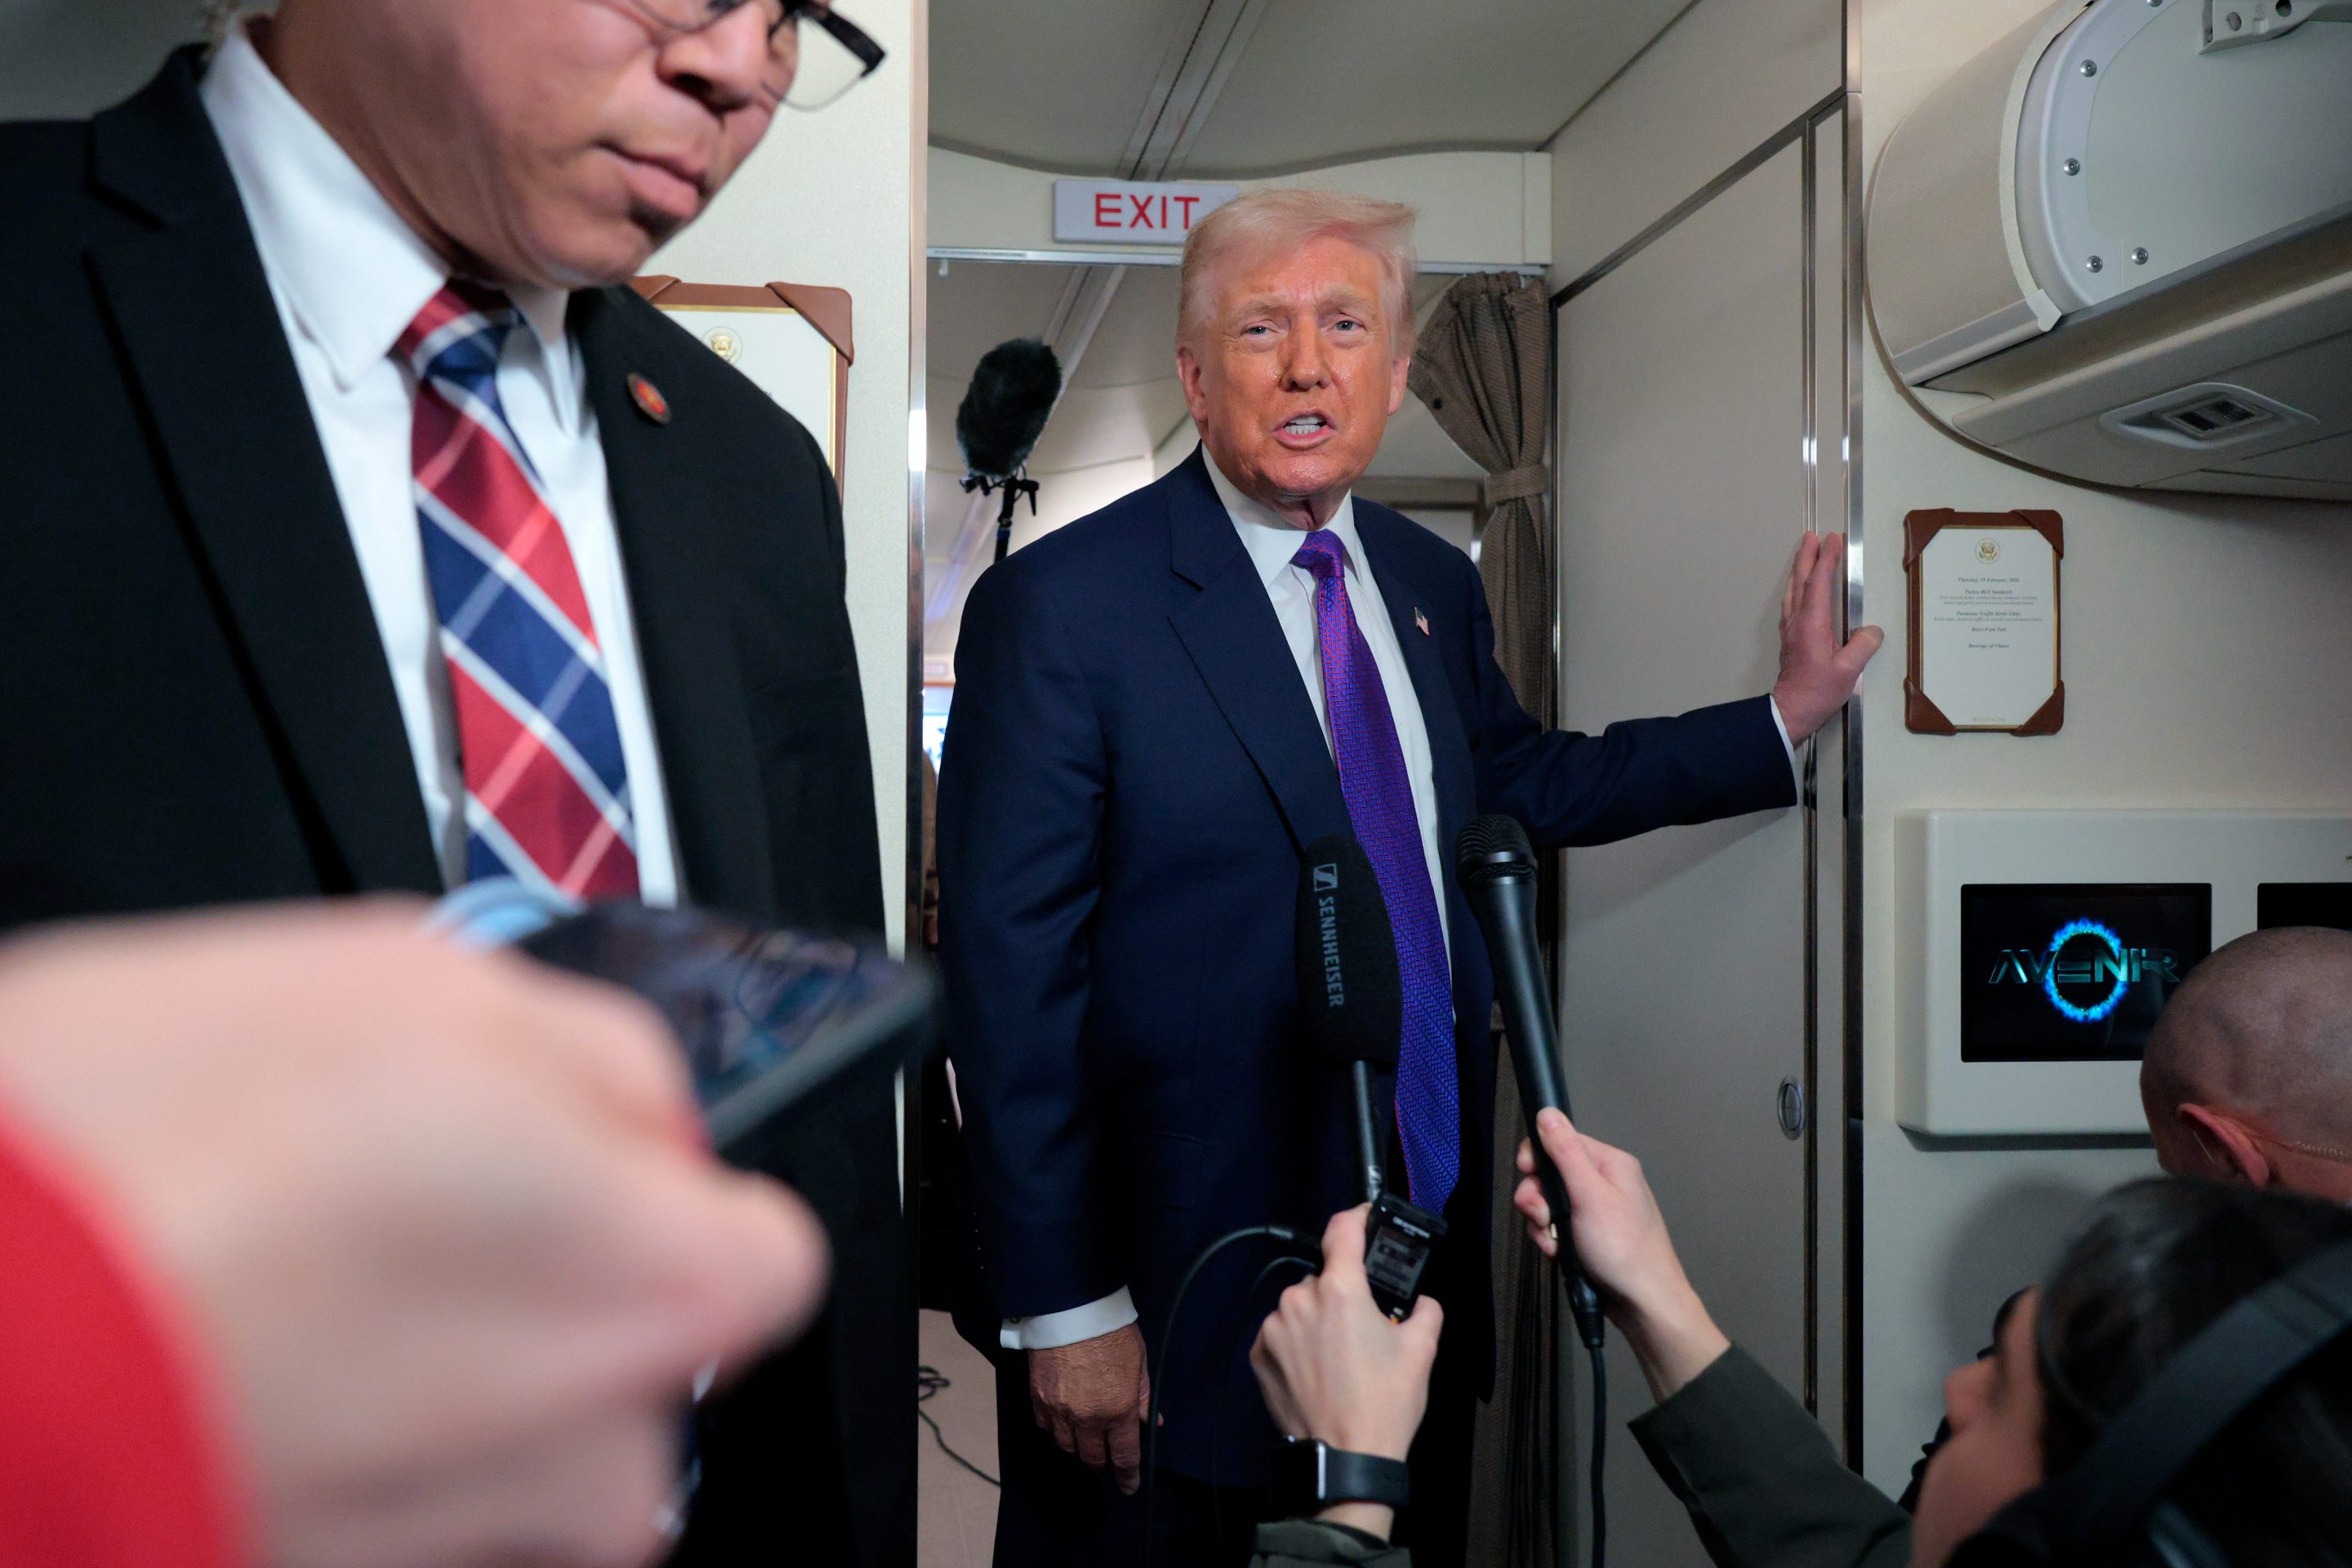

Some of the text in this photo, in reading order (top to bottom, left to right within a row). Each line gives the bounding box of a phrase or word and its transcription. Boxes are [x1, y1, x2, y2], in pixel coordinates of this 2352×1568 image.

[1095, 193, 1200, 229] EXIT
[1319, 896, 1344, 1008] SENNHEISER
[1989, 948, 2180, 983] AVENIR
